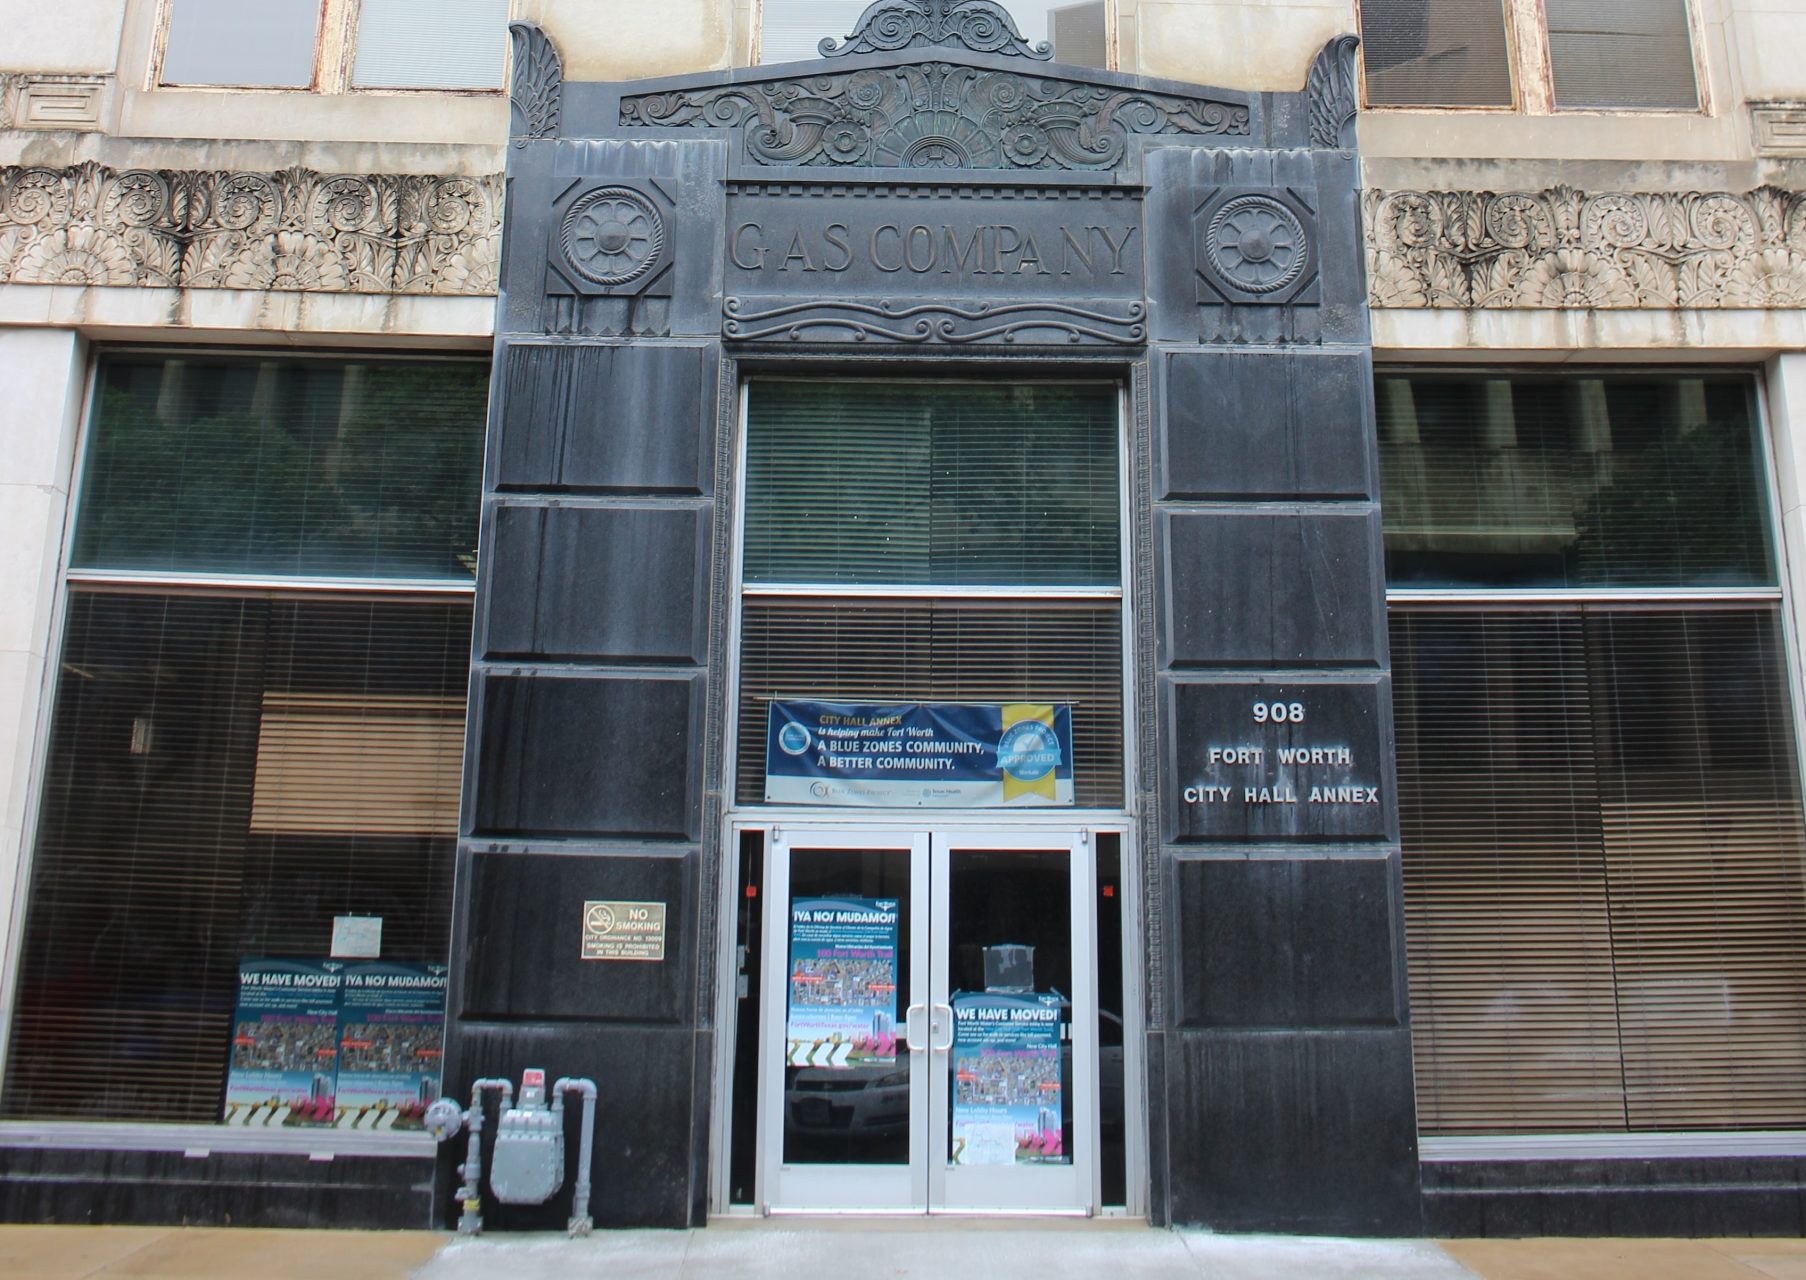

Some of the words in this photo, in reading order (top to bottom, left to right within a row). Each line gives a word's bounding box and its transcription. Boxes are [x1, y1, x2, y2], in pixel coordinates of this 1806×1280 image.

[728, 221, 855, 272] GAS
[869, 223, 1138, 276] COMPANY
[1252, 702, 1305, 723] 908
[819, 715, 840, 725] CITY
[843, 716, 865, 726] HALL
[869, 715, 902, 726] ANNEX
[827, 727, 859, 738] helping
[861, 727, 884, 737] make
[887, 727, 904, 737] Fort
[907, 727, 934, 737] Worth
[817, 740, 827, 751] A
[830, 741, 859, 752] BLUE
[863, 741, 902, 752] ZONES
[906, 741, 984, 755] COMMUNITY,
[1001, 753, 1055, 764] APPROVED
[1209, 747, 1263, 765] FORT
[1277, 747, 1351, 765] WORTH
[817, 756, 826, 767] A
[830, 757, 873, 768] BETTER
[876, 757, 955, 770] COMMUNITY.
[1184, 787, 1232, 803] CITY
[1245, 787, 1297, 803] HALL
[1308, 787, 1379, 803] ANNEX
[629, 908, 648, 920] NO
[813, 911, 834, 922] NOS
[836, 912, 896, 923] MUDAMOS!
[616, 921, 660, 930] SMOKING
[240, 972, 260, 985] WE
[261, 973, 292, 986] HAVE
[293, 974, 341, 987] MOVED!
[365, 975, 386, 987] NOS
[956, 1008, 976, 1020] WE
[978, 1008, 1008, 1020] HAVE
[1011, 1009, 1058, 1021] MOVED!
